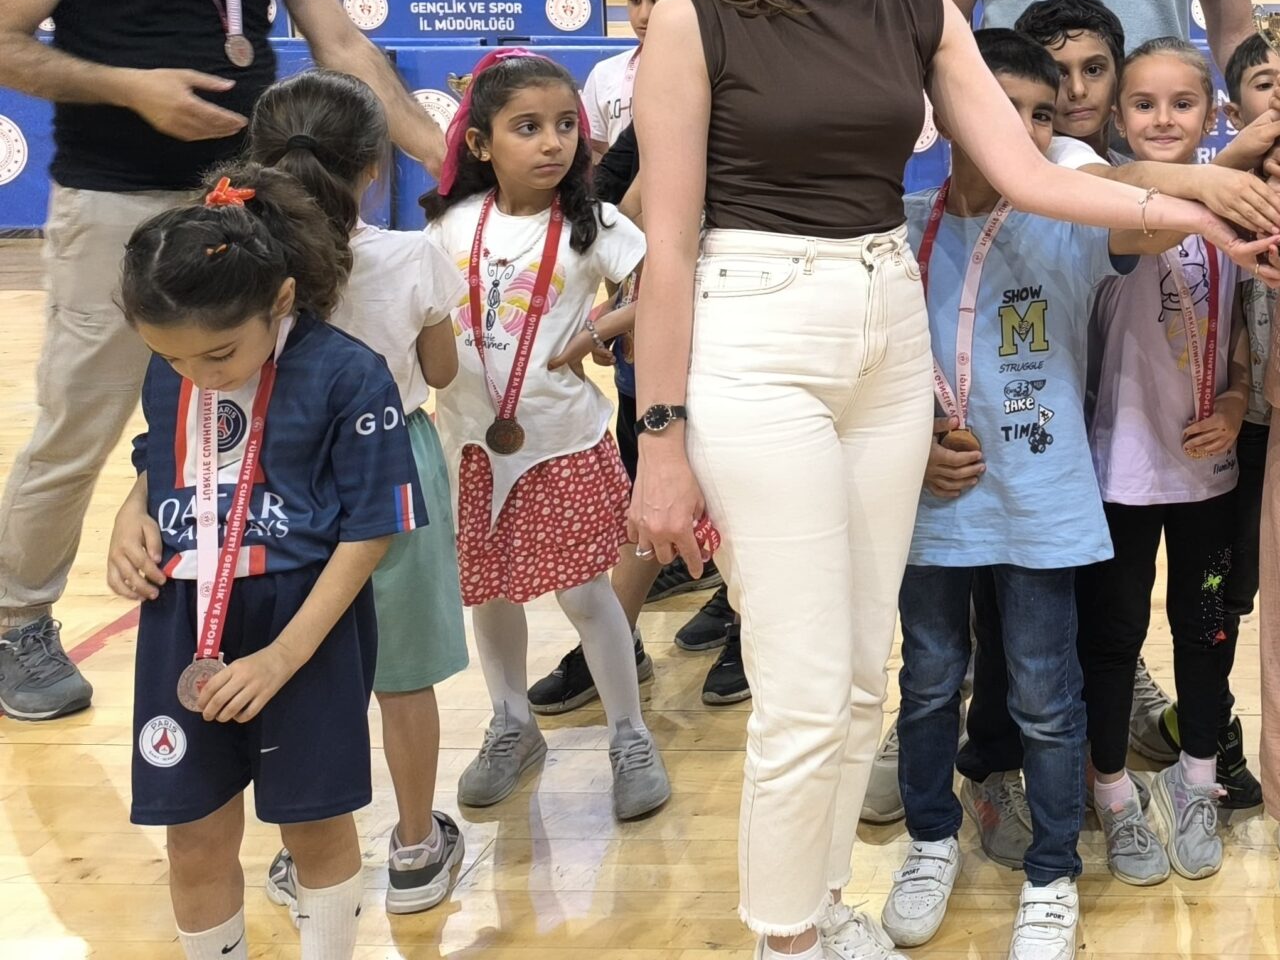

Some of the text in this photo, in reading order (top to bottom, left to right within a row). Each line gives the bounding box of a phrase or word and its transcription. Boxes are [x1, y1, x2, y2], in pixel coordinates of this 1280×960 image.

[410, 0, 523, 16] GENÇLİK VE SPOR
[420, 17, 515, 31] İL MÜDÜRLÜĞÜ
[1003, 286, 1042, 304] SHOW
[998, 300, 1049, 357] M
[999, 361, 1044, 373] STRUGGLE
[217, 406, 237, 419] ARIS
[240, 440, 257, 480] TÜRKİYE
[227, 483, 248, 551] CUMHURİYETİ
[215, 555, 232, 600] GENÇLİK
[212, 602, 222, 615] VE
[205, 618, 219, 645] SPOR
[151, 719, 178, 733] PARIS
[1045, 912, 1065, 920] SPORT
